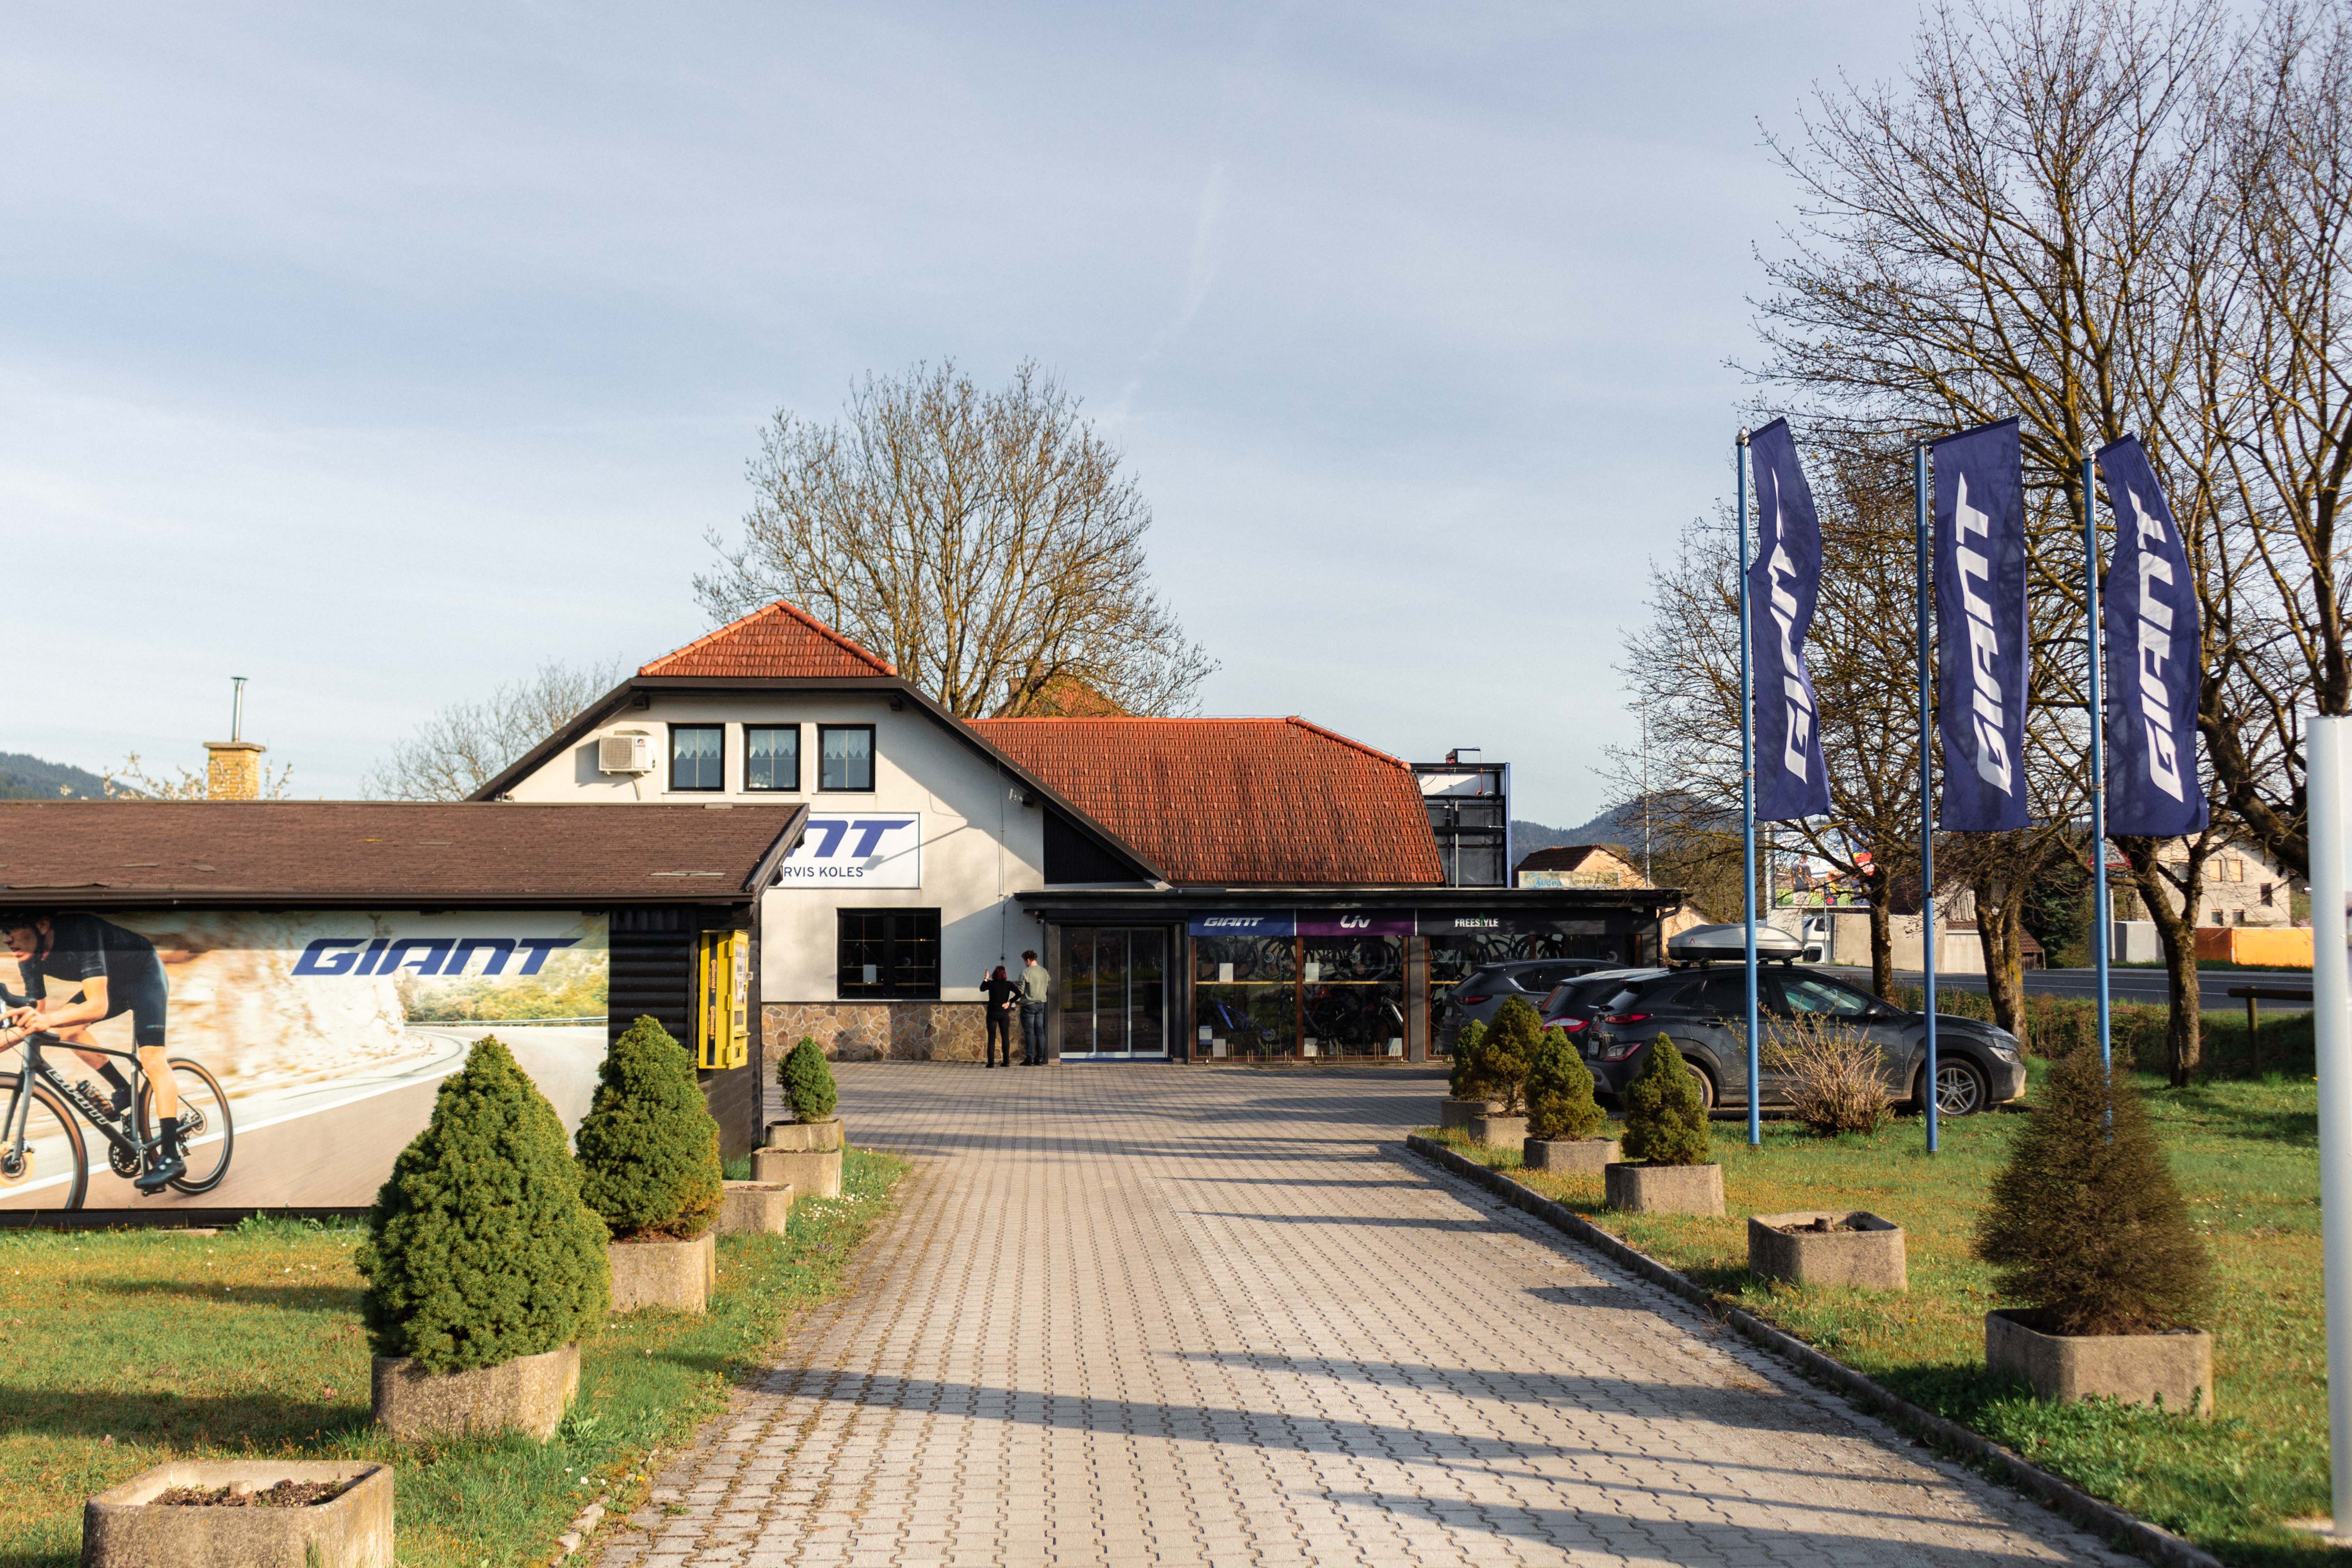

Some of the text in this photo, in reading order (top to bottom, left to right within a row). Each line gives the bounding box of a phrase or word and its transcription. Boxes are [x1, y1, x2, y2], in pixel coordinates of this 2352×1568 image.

[1768, 468, 1812, 785] GIAN
[1955, 471, 2013, 798] GIANT
[2126, 480, 2184, 803] GIANT
[784, 867, 863, 877] RVIS KOLES
[1203, 917, 1265, 926] GIANT
[1340, 915, 1370, 928] Liv
[291, 938, 583, 975] GIANT
